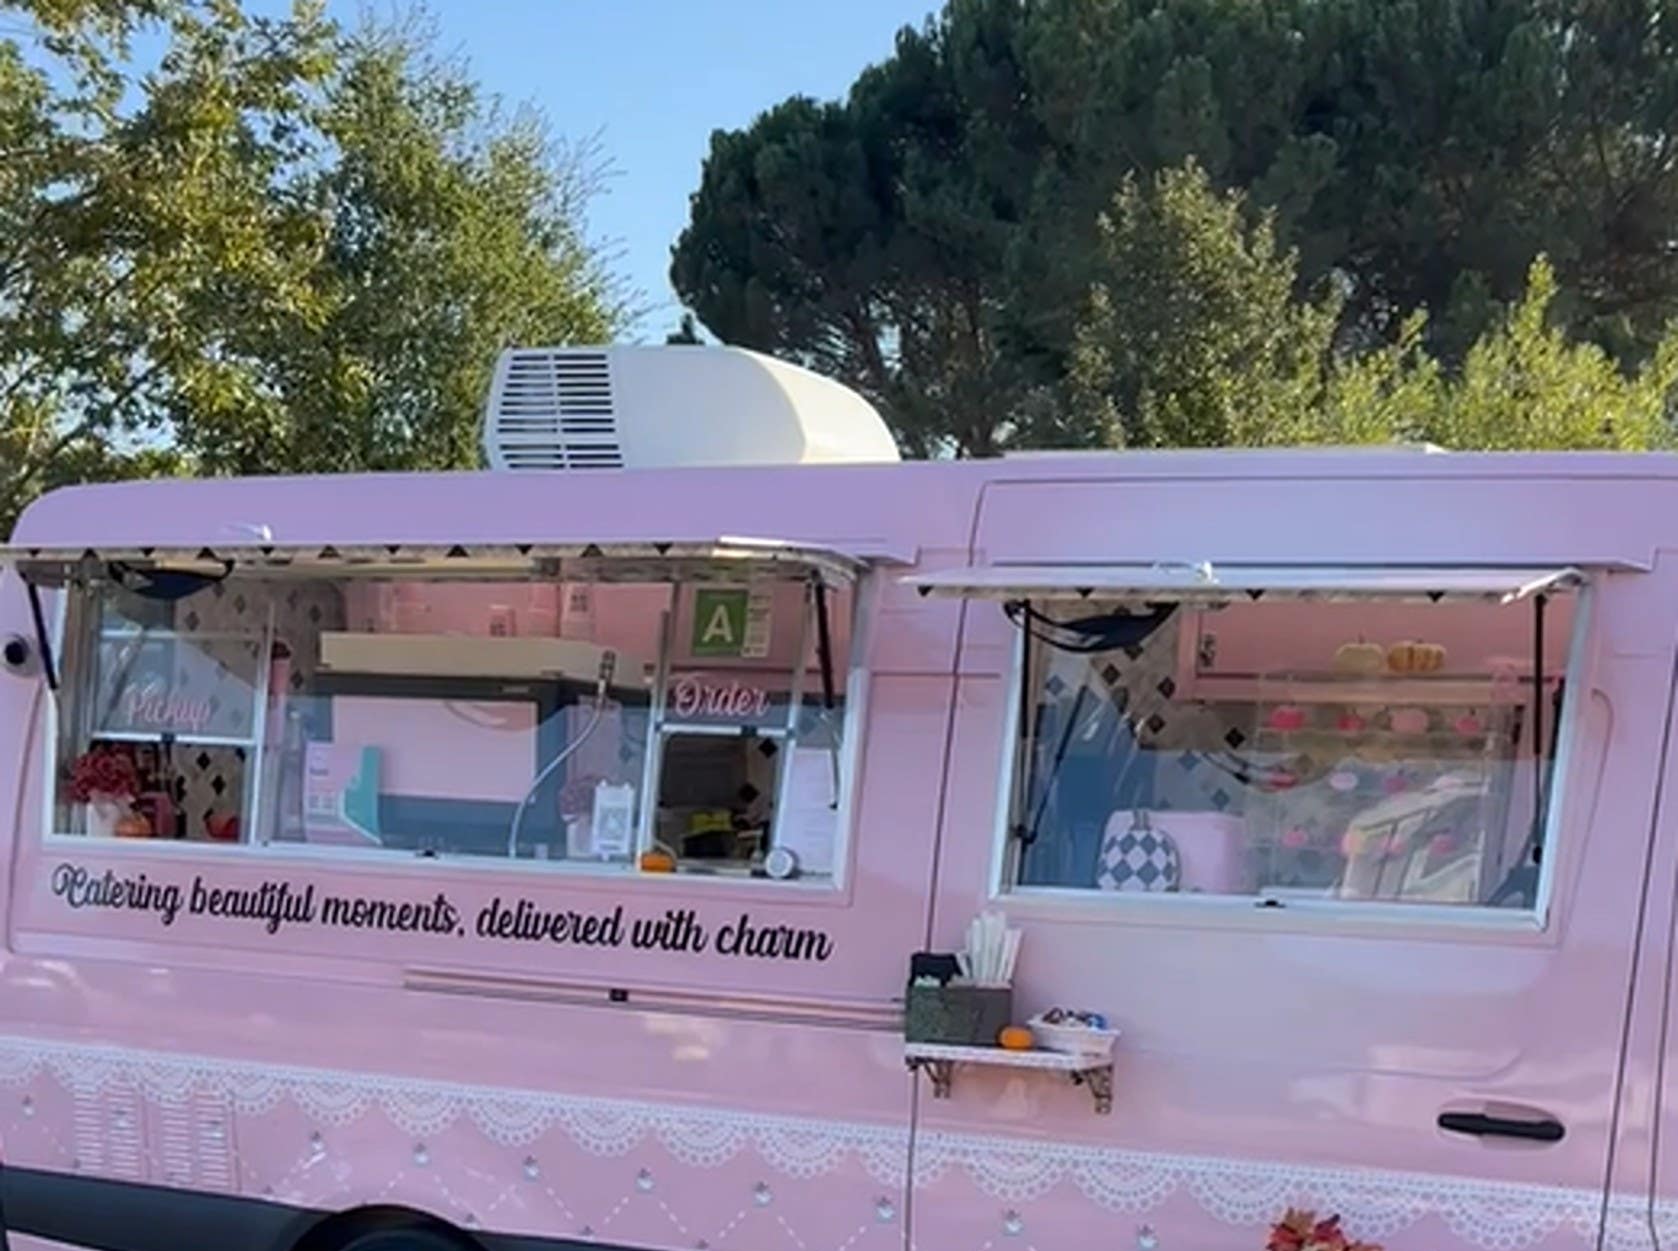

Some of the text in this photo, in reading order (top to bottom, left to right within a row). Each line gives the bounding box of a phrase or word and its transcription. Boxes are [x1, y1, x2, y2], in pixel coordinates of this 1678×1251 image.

[702, 604, 734, 643] A
[672, 675, 771, 719] Order
[51, 863, 184, 926] Catering
[189, 876, 316, 934] beautiful
[475, 898, 624, 948] delivered
[630, 909, 709, 954] with
[714, 914, 834, 961] charm
